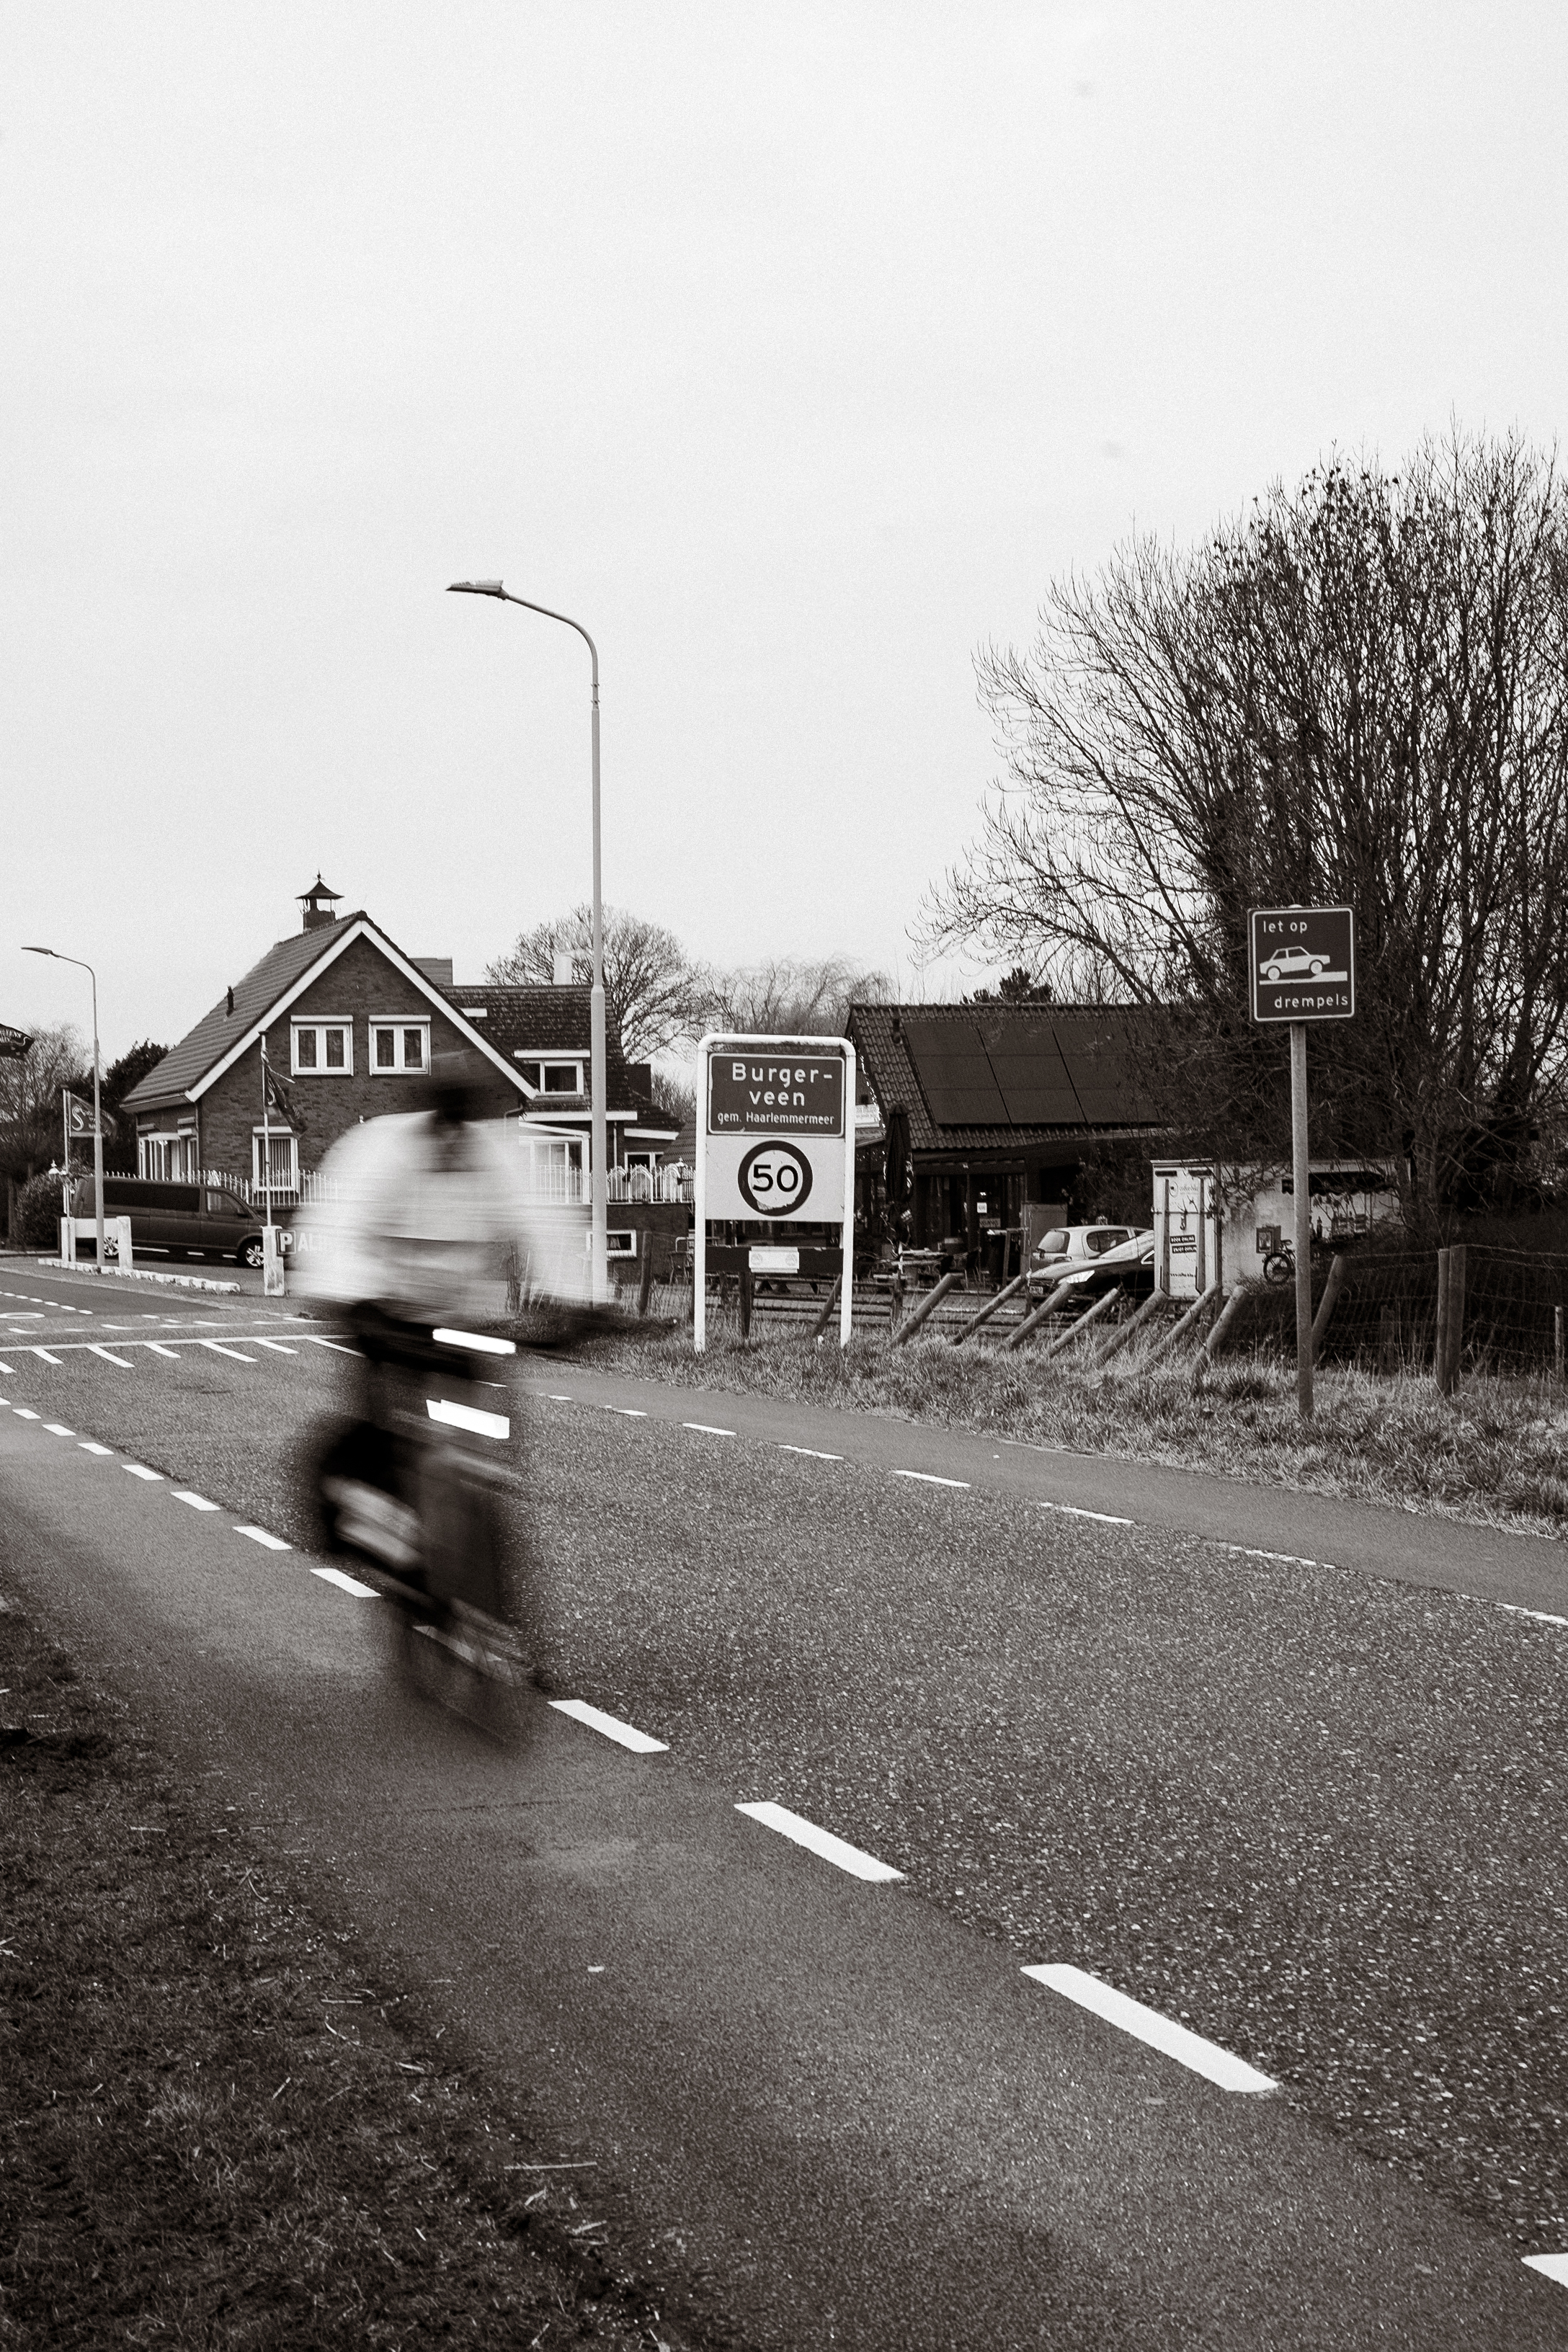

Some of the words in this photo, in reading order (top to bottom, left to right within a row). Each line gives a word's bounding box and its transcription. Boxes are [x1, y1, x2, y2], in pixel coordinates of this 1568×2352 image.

[1263, 920, 1283, 933] let
[1290, 922, 1307, 934] op
[1274, 994, 1348, 1009] drempels
[732, 1062, 833, 1088] Burger-
[749, 1090, 805, 1106] veen
[717, 1112, 742, 1126] gem.
[746, 1112, 834, 1126] Haarlemmermeer
[752, 1164, 798, 1193] 50
[280, 1232, 293, 1252] P
